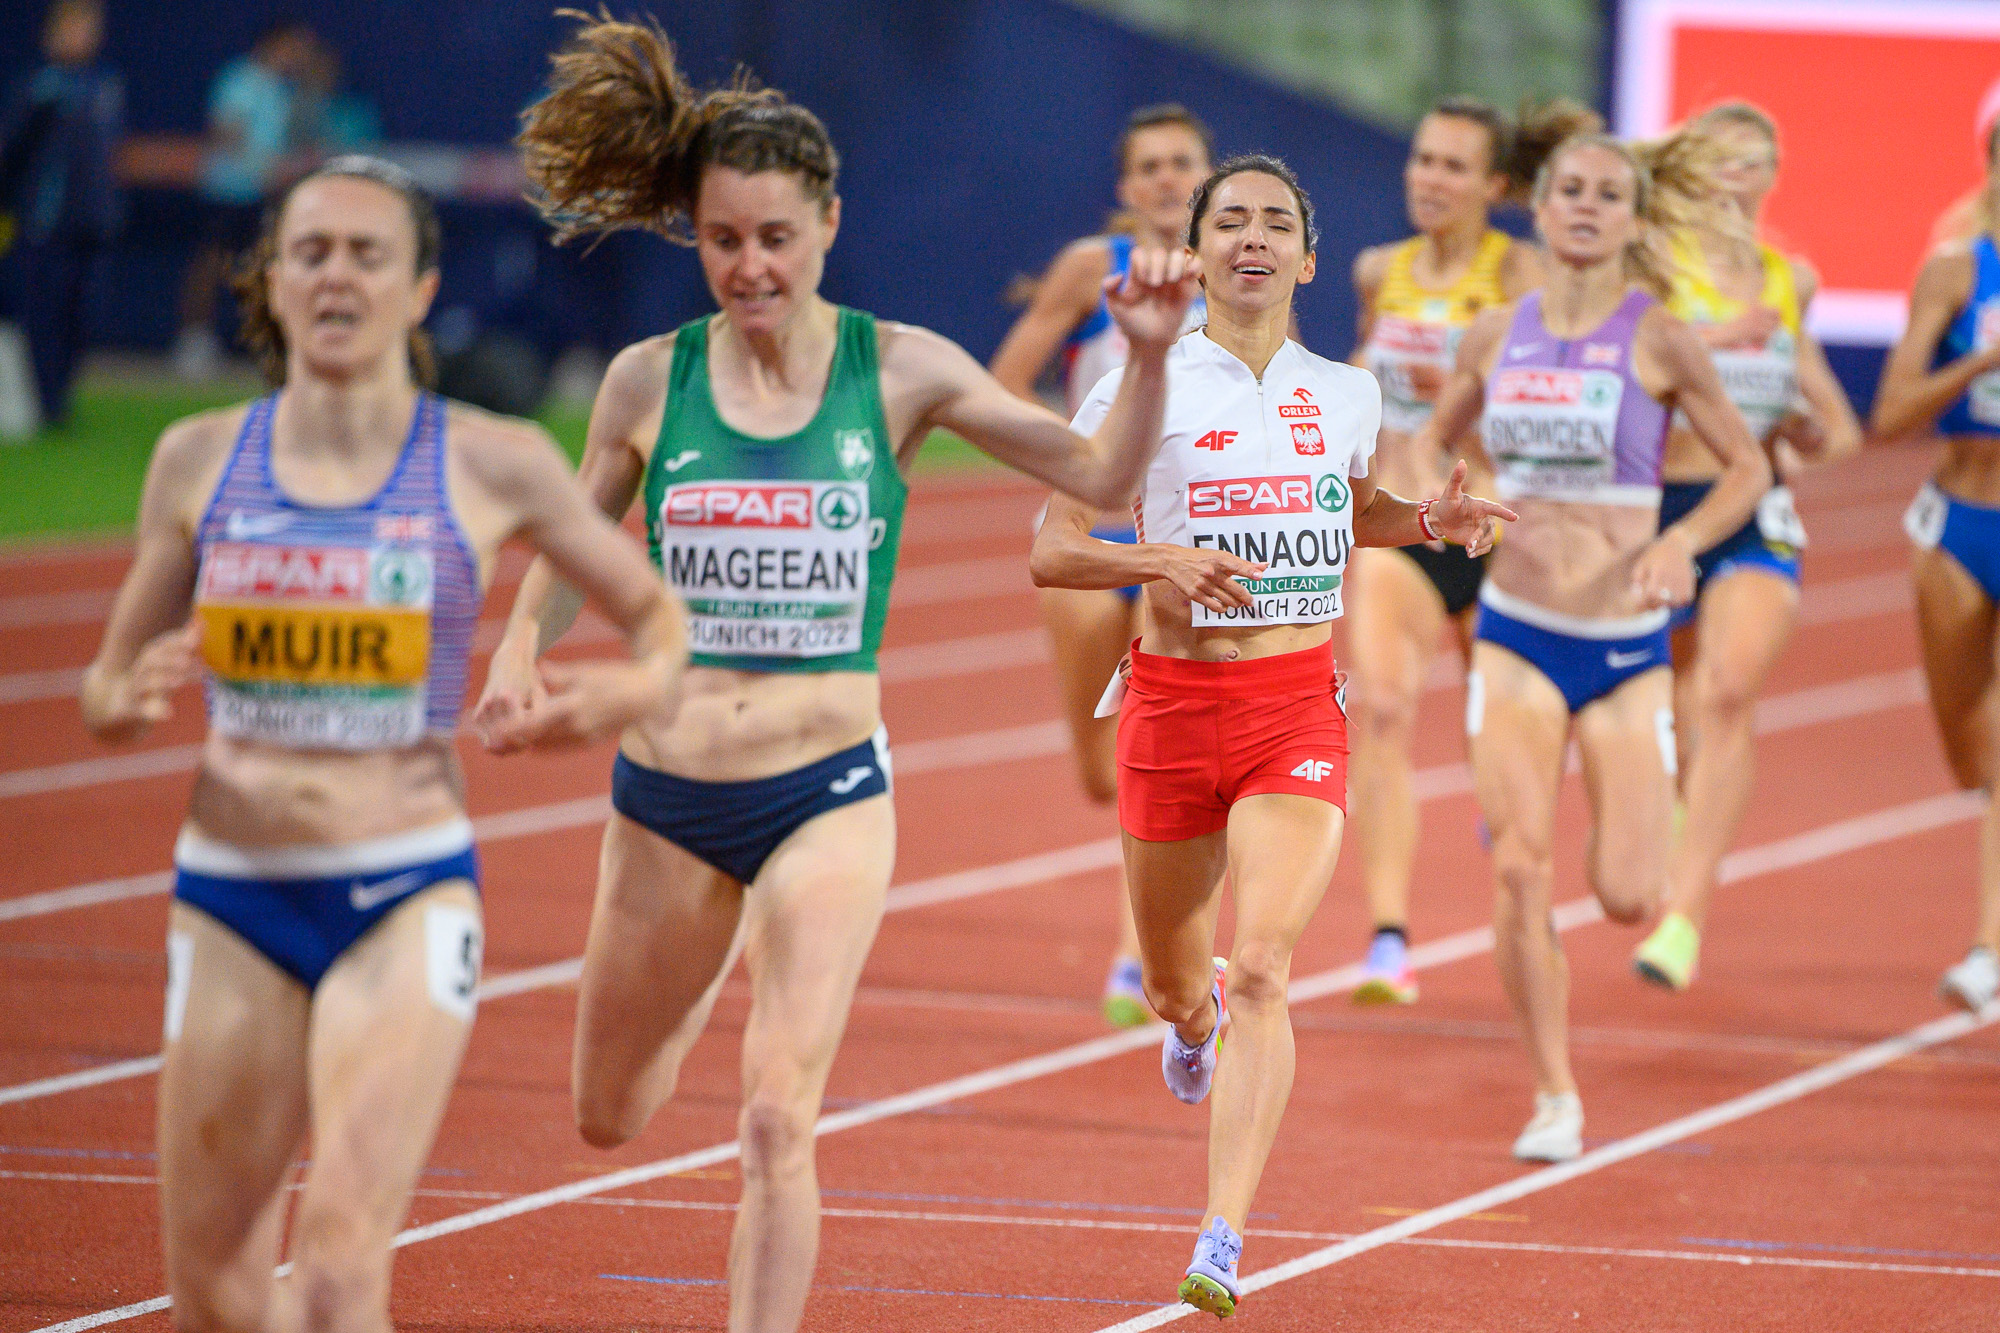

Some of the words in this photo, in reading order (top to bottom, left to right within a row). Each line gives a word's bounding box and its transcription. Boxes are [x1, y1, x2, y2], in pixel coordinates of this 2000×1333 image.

[1281, 406, 1318, 417] ORLEN
[1194, 430, 1239, 451] 4F
[669, 490, 810, 525] SPAR
[1192, 480, 1309, 512] SPAR
[671, 545, 858, 591] MAGEEAN
[1297, 592, 1338, 617] 2022
[232, 620, 394, 673] MUIR
[789, 621, 850, 649] 2022
[1290, 758, 1334, 782] 4F
